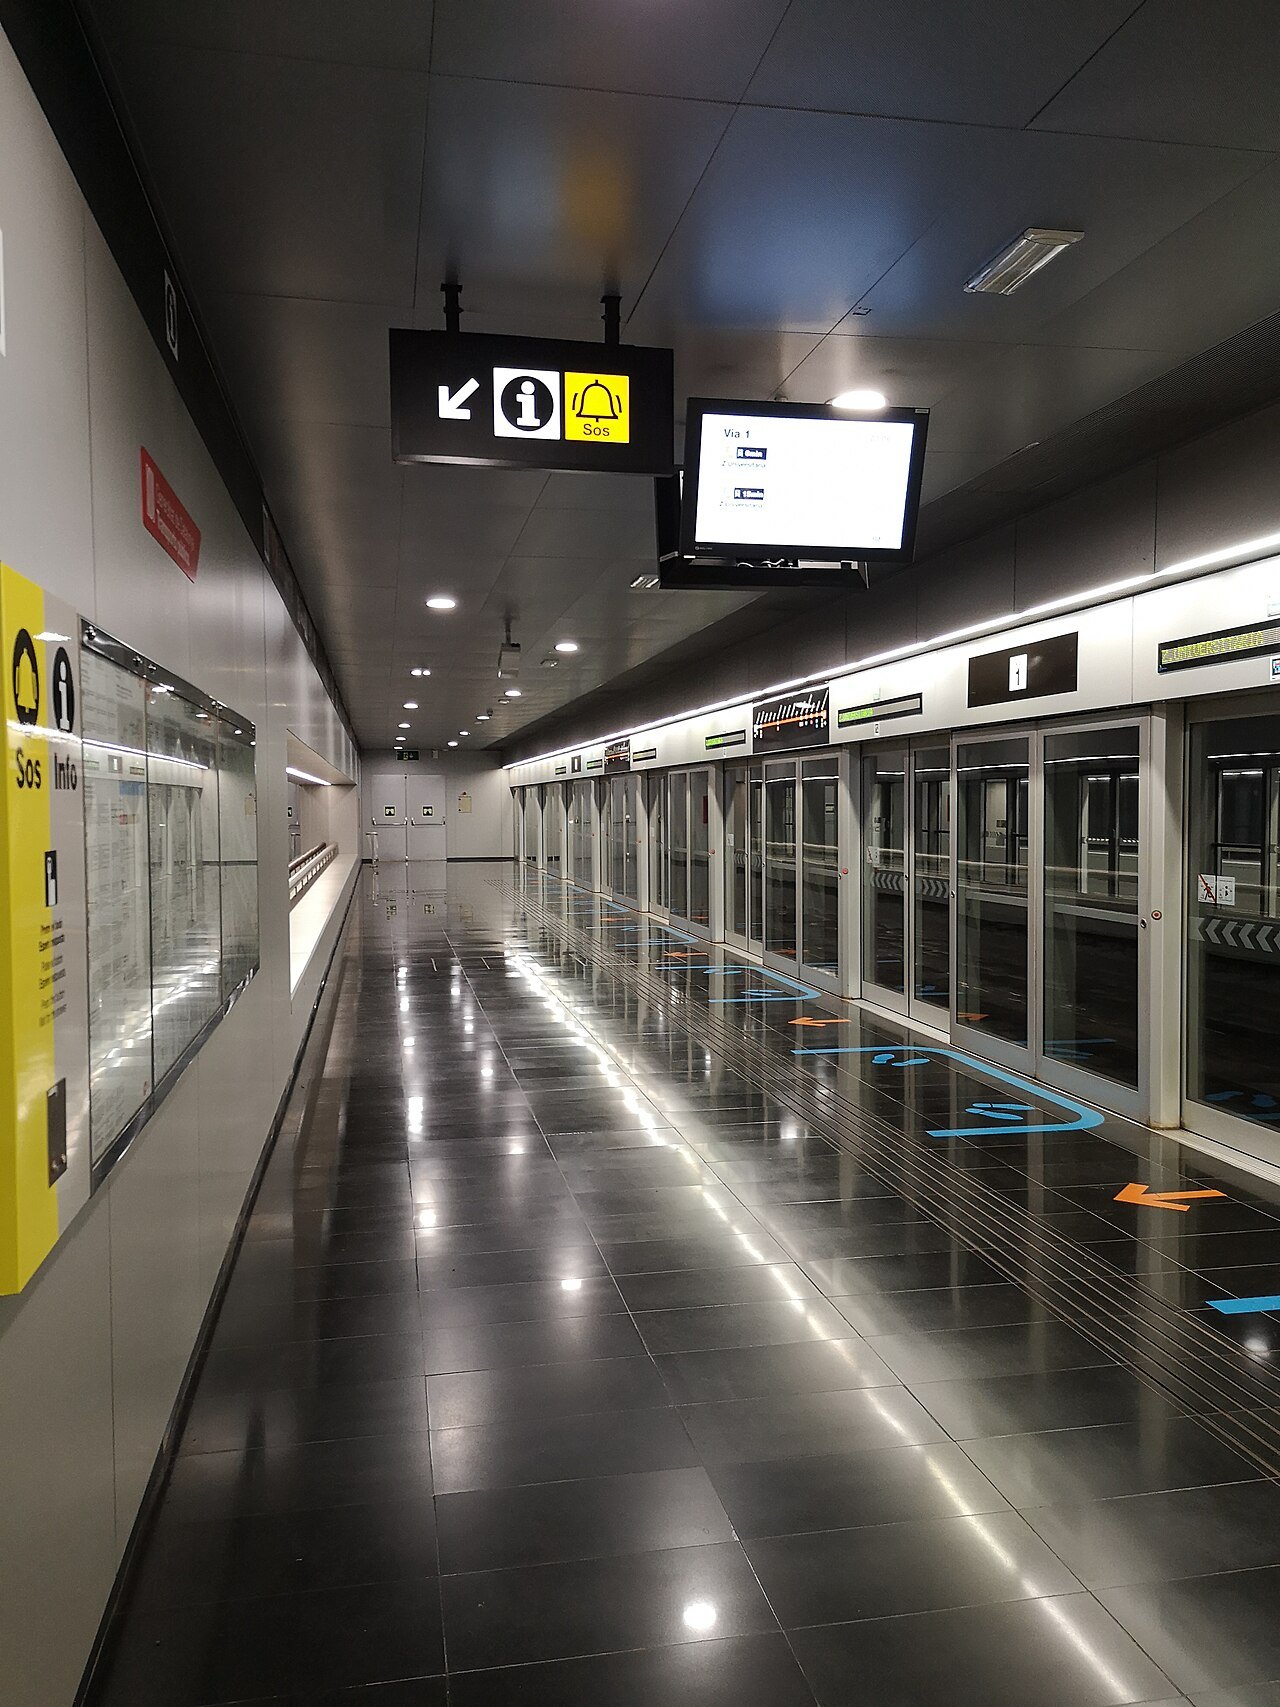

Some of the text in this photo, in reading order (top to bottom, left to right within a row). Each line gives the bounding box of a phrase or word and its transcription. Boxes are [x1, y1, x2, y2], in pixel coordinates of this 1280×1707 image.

[582, 424, 611, 437] Sos
[724, 428, 741, 438] Via
[16, 746, 41, 789] Sos
[54, 752, 77, 790] Info
